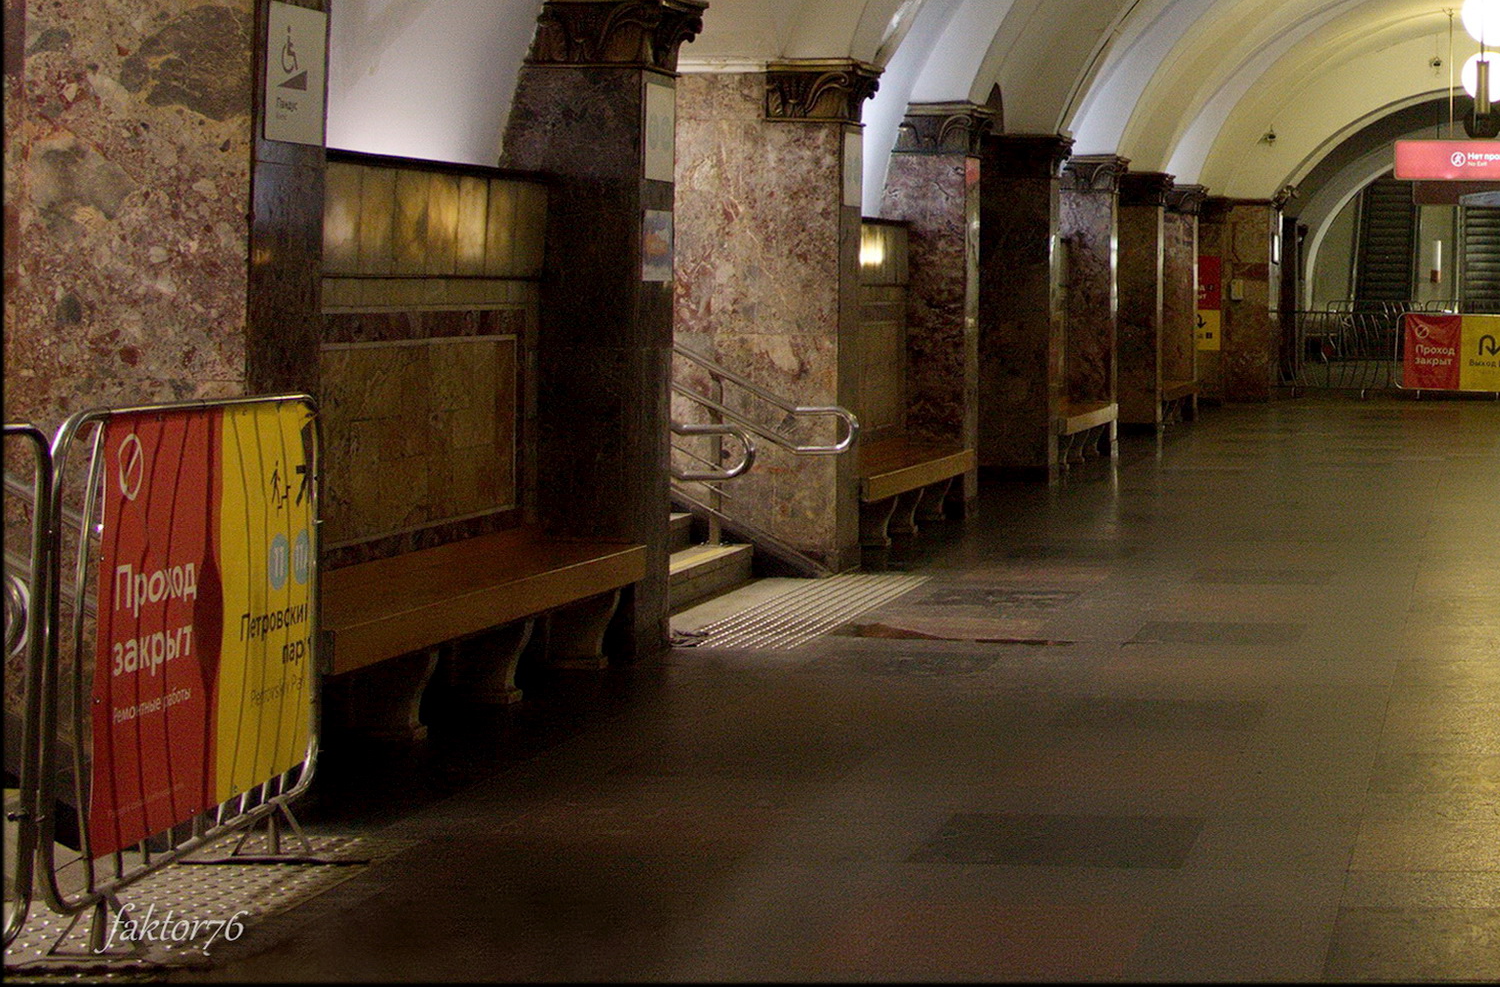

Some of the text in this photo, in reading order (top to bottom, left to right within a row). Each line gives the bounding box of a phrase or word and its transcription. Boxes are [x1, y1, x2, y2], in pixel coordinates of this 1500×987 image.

[1467, 152, 1483, 160] Нет
[1415, 344, 1456, 356] Проход
[1414, 356, 1453, 367] закрыт
[1469, 359, 1497, 368] Выход
[115, 562, 197, 619] Проход
[112, 624, 194, 678] закрыт
